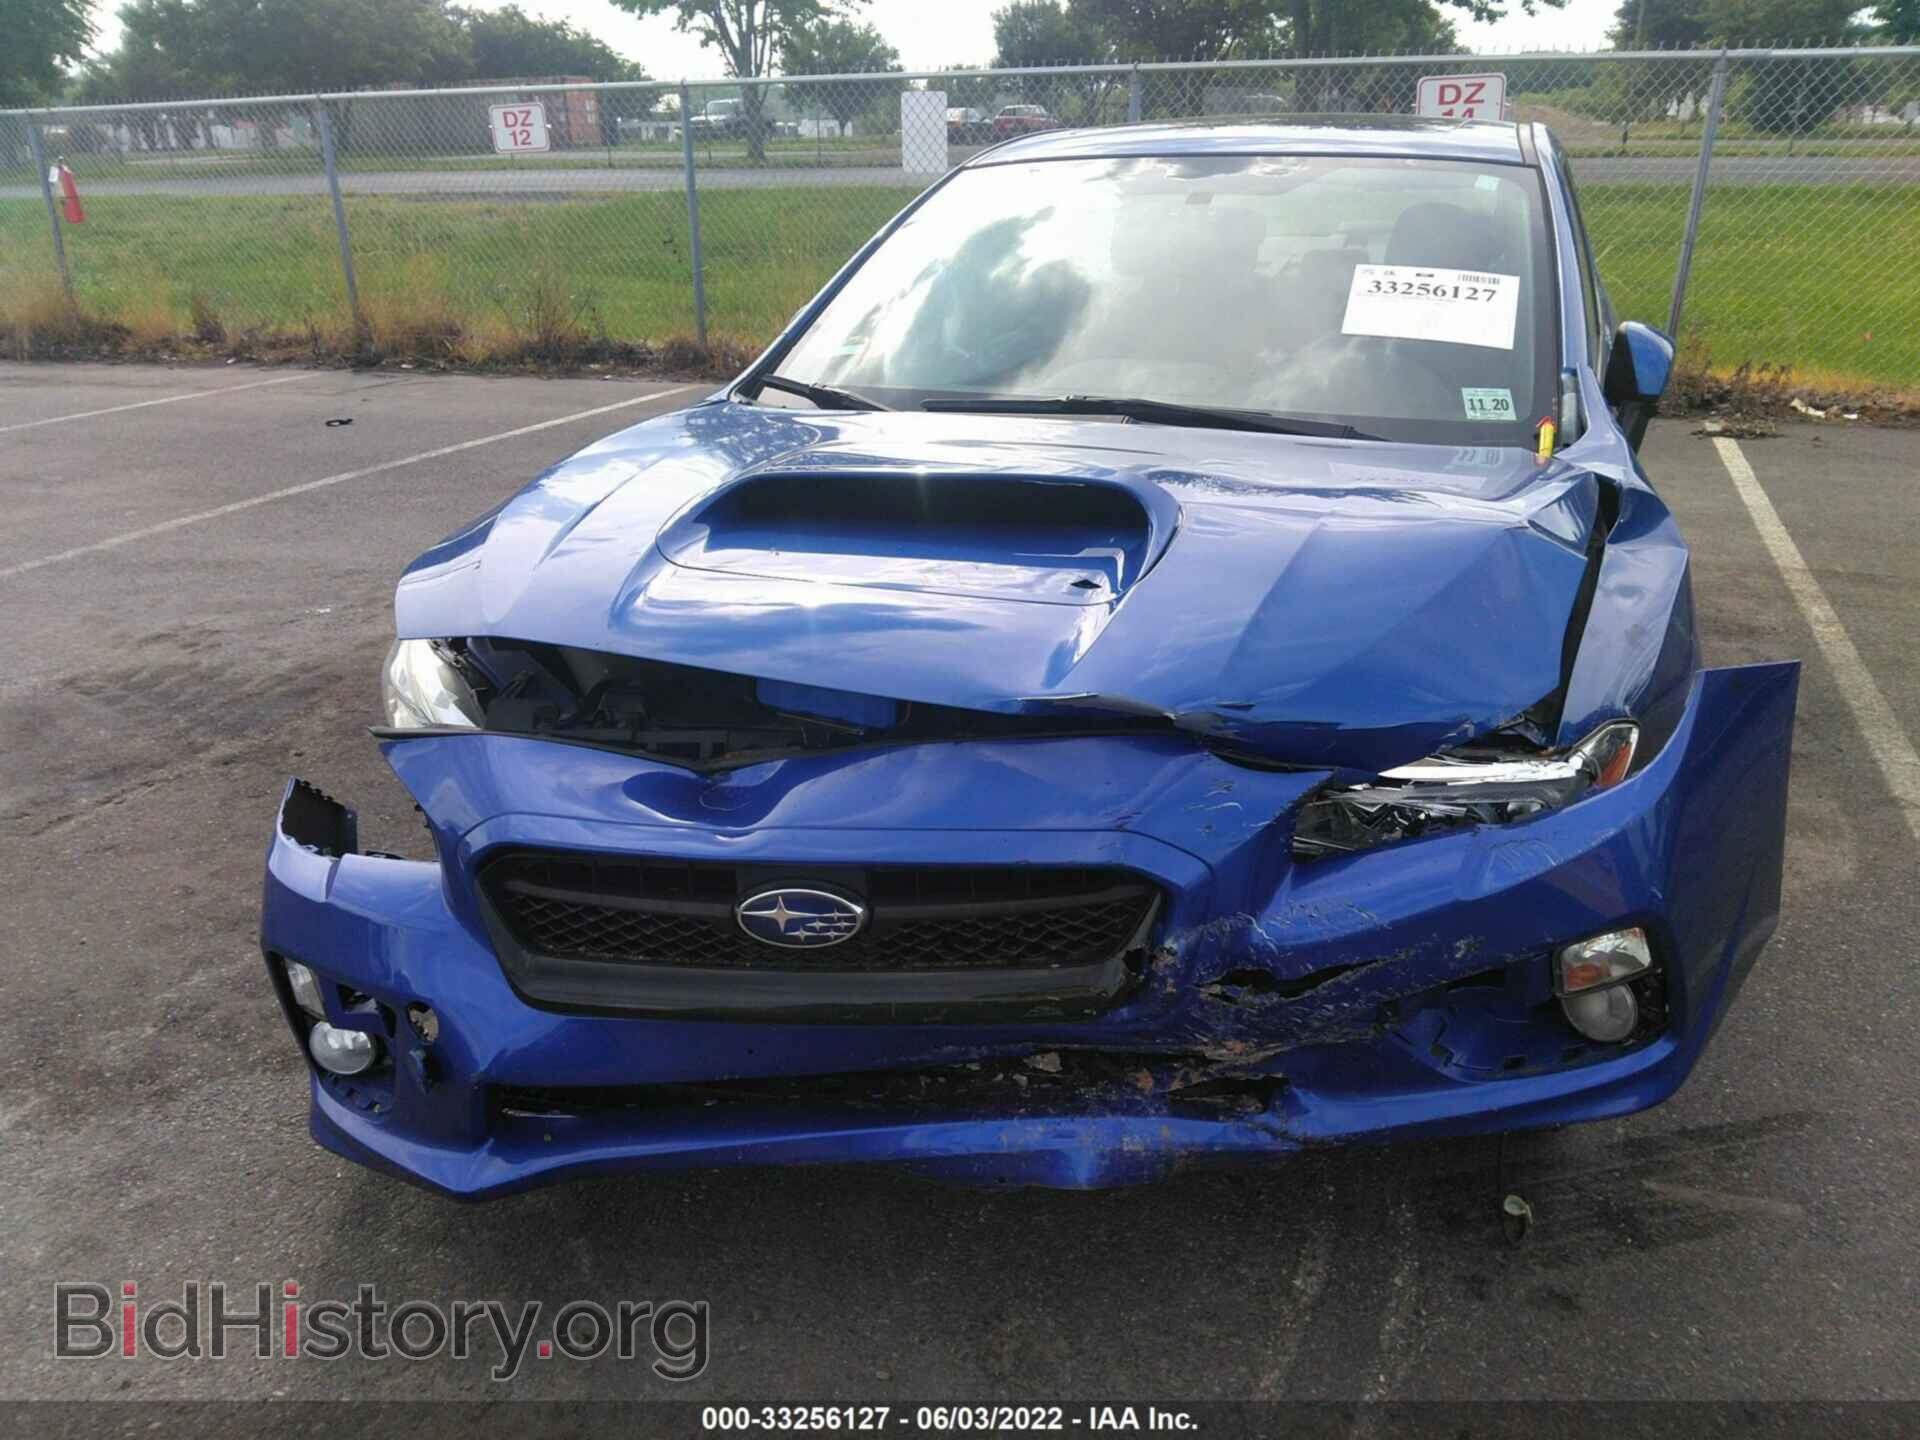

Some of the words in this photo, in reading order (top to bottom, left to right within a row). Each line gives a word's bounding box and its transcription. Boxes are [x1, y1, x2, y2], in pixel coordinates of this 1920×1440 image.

[1438, 82, 1486, 106] DZ
[502, 109, 534, 128] DZ
[508, 129, 532, 147] 12
[1367, 280, 1497, 302] 33256127
